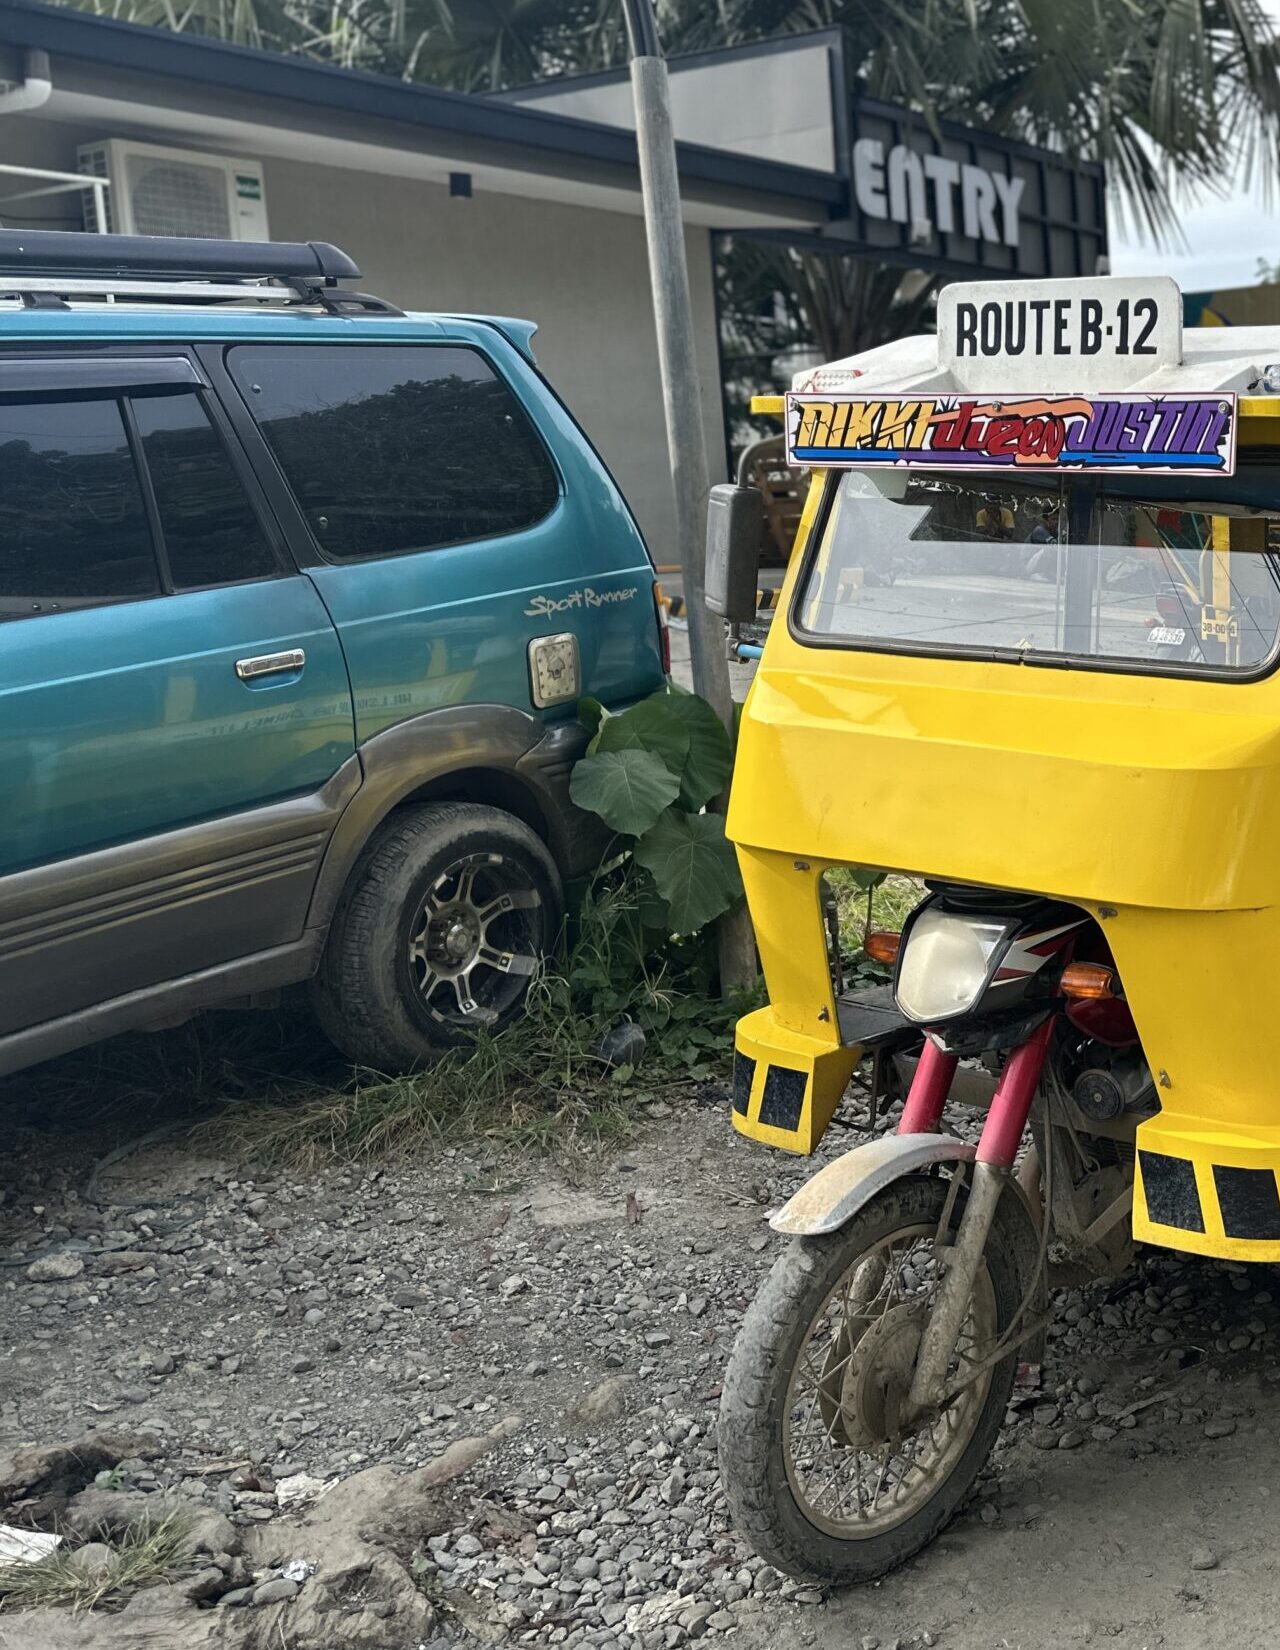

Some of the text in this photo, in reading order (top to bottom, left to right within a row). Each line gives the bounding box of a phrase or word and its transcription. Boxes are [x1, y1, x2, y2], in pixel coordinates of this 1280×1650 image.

[853, 138, 1025, 246] ENTRY
[956, 299, 1072, 357] ROUTE
[1066, 400, 1229, 453] JUSTIN
[524, 588, 638, 621] Sport Runner
